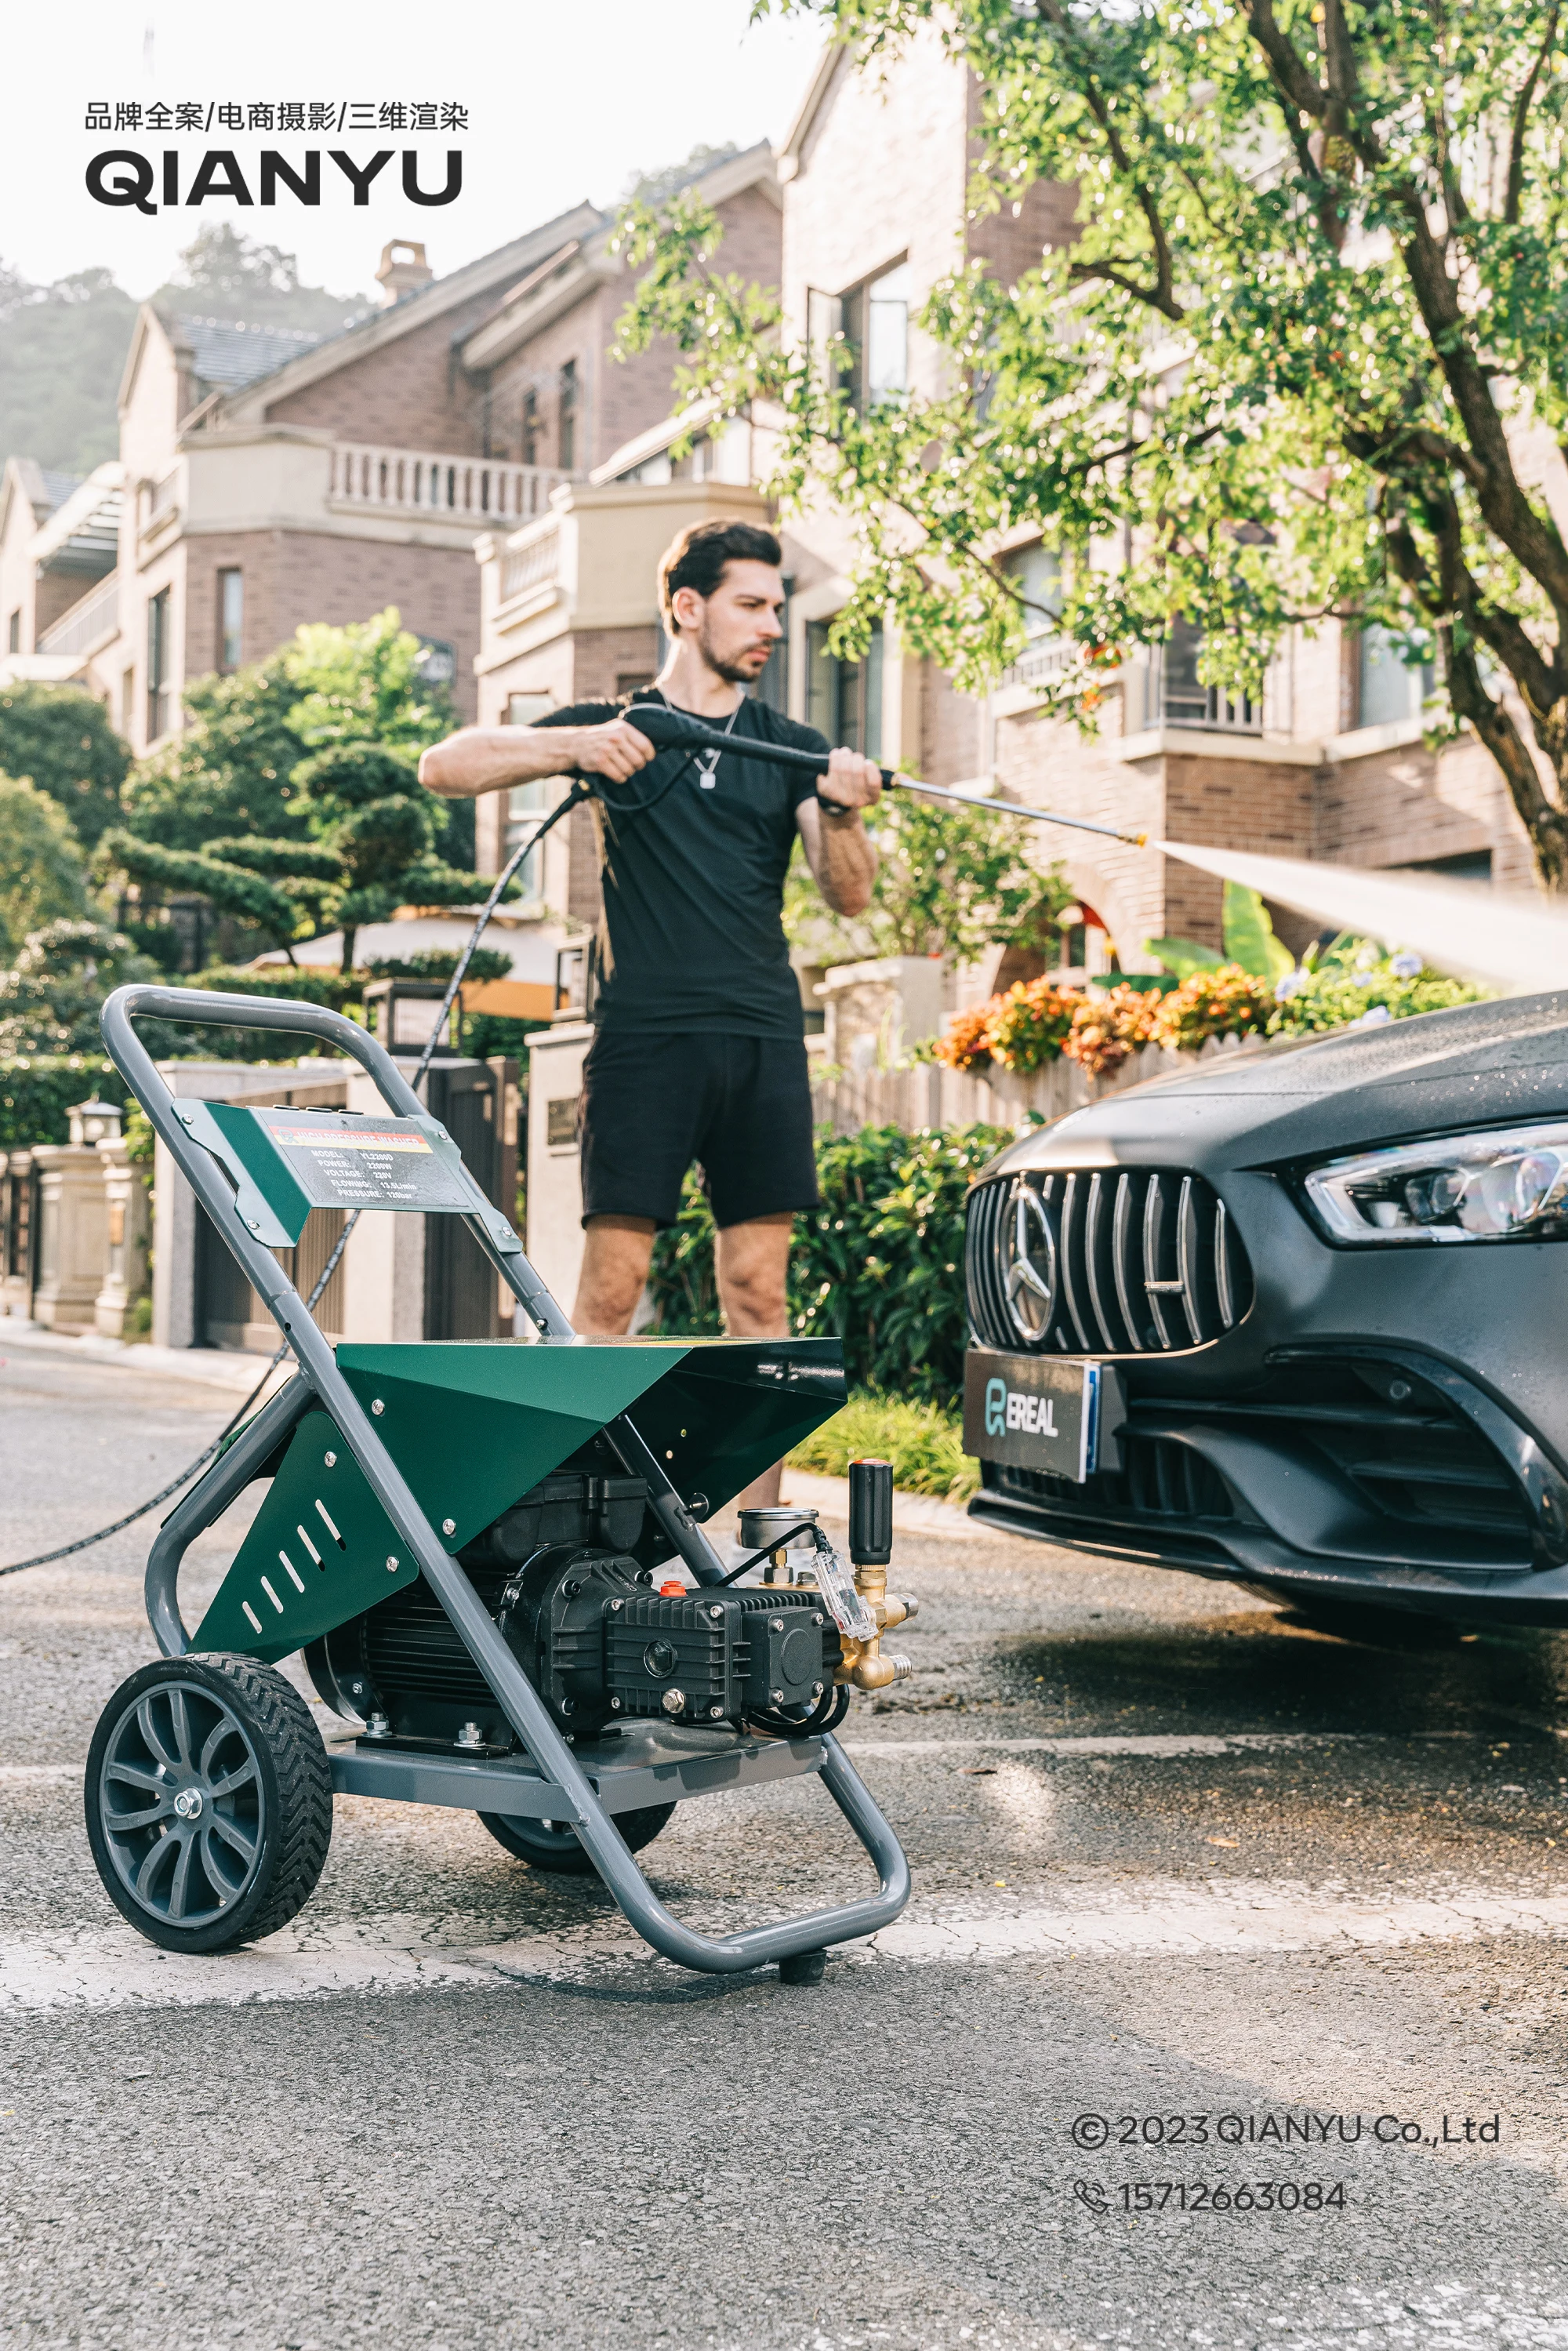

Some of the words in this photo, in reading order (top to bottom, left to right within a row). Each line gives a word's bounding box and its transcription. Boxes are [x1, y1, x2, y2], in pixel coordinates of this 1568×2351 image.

[297, 1132, 325, 1145] HIGH
[324, 1133, 381, 1148] PRESSURE
[377, 1136, 423, 1150] WASHER
[310, 1150, 344, 1158] MODEL:
[360, 1152, 394, 1161] YL2200D
[317, 1159, 351, 1168] POWER:
[324, 1168, 365, 1178] VOLTAGE:
[330, 1179, 372, 1188] FLOWING:
[379, 1182, 417, 1190] 13.5L/min
[336, 1189, 384, 1198] PRESSURE:
[1006, 1392, 1058, 1438] EREAL
